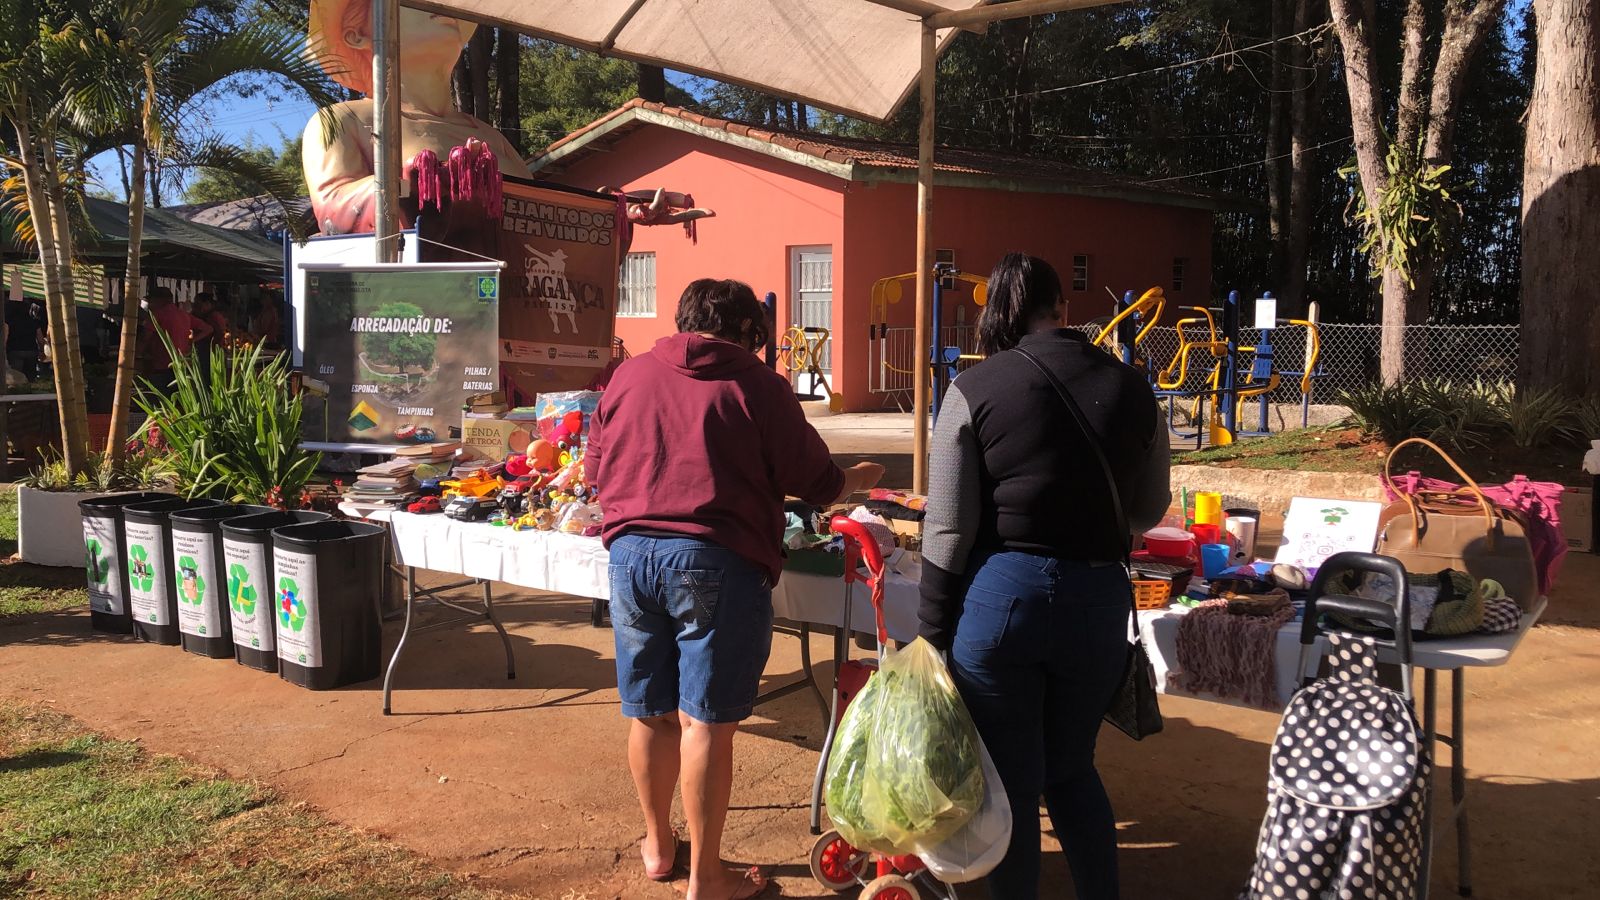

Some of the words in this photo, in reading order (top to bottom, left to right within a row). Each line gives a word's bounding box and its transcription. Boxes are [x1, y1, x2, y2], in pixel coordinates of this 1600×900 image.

[557, 207, 615, 229] TODOS
[502, 215, 542, 236] BEM
[544, 222, 611, 246] VINDOS
[504, 274, 606, 311] RAGANÇA
[350, 315, 431, 337] ARRECADAÇÃO
[433, 318, 453, 334] DE:
[319, 362, 335, 374] ÓLEO
[464, 366, 487, 376] PILHAS
[351, 384, 379, 394] ESPONJA
[463, 381, 493, 391] BATERIAS
[397, 407, 434, 417] TAMPINHAS
[465, 427, 501, 437] TENDA
[465, 437, 476, 445] DE
[477, 437, 503, 446] TROCA
